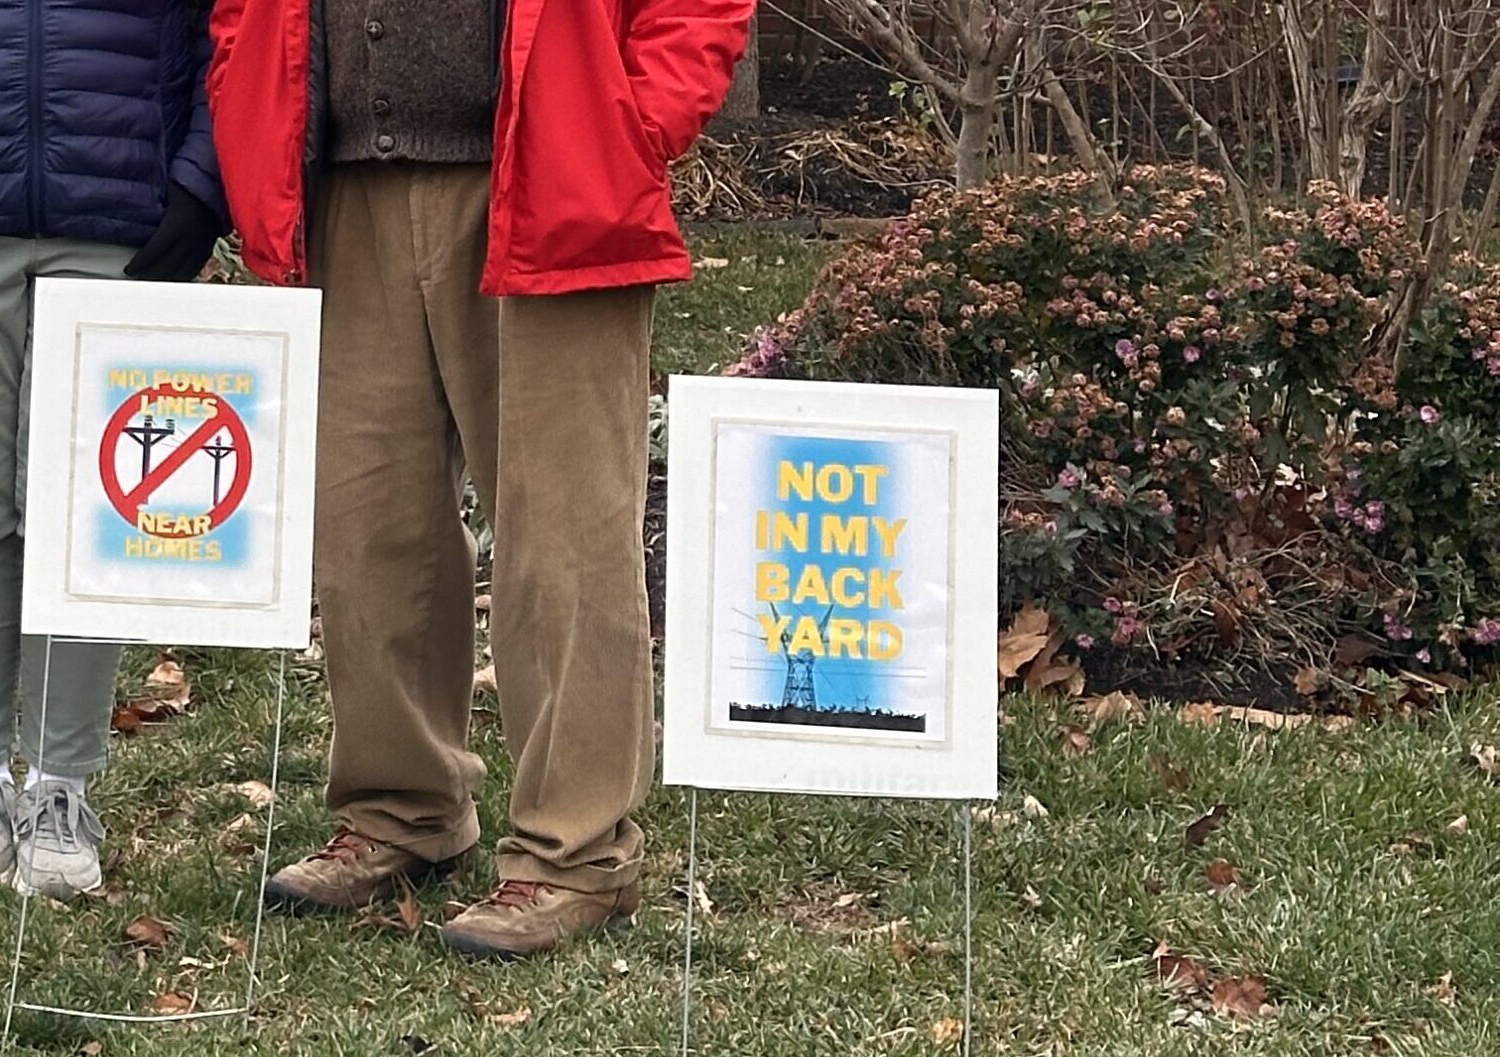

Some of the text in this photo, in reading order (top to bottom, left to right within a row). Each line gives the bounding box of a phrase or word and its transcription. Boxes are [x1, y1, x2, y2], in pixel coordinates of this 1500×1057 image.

[107, 368, 254, 395] NO POWER
[138, 394, 220, 421] LINES
[777, 460, 890, 505] NOT
[137, 511, 212, 535] NEAR
[755, 510, 908, 559] IN MY
[124, 536, 221, 561] HOMES
[755, 561, 905, 610] BACK
[756, 613, 905, 661] YARD
